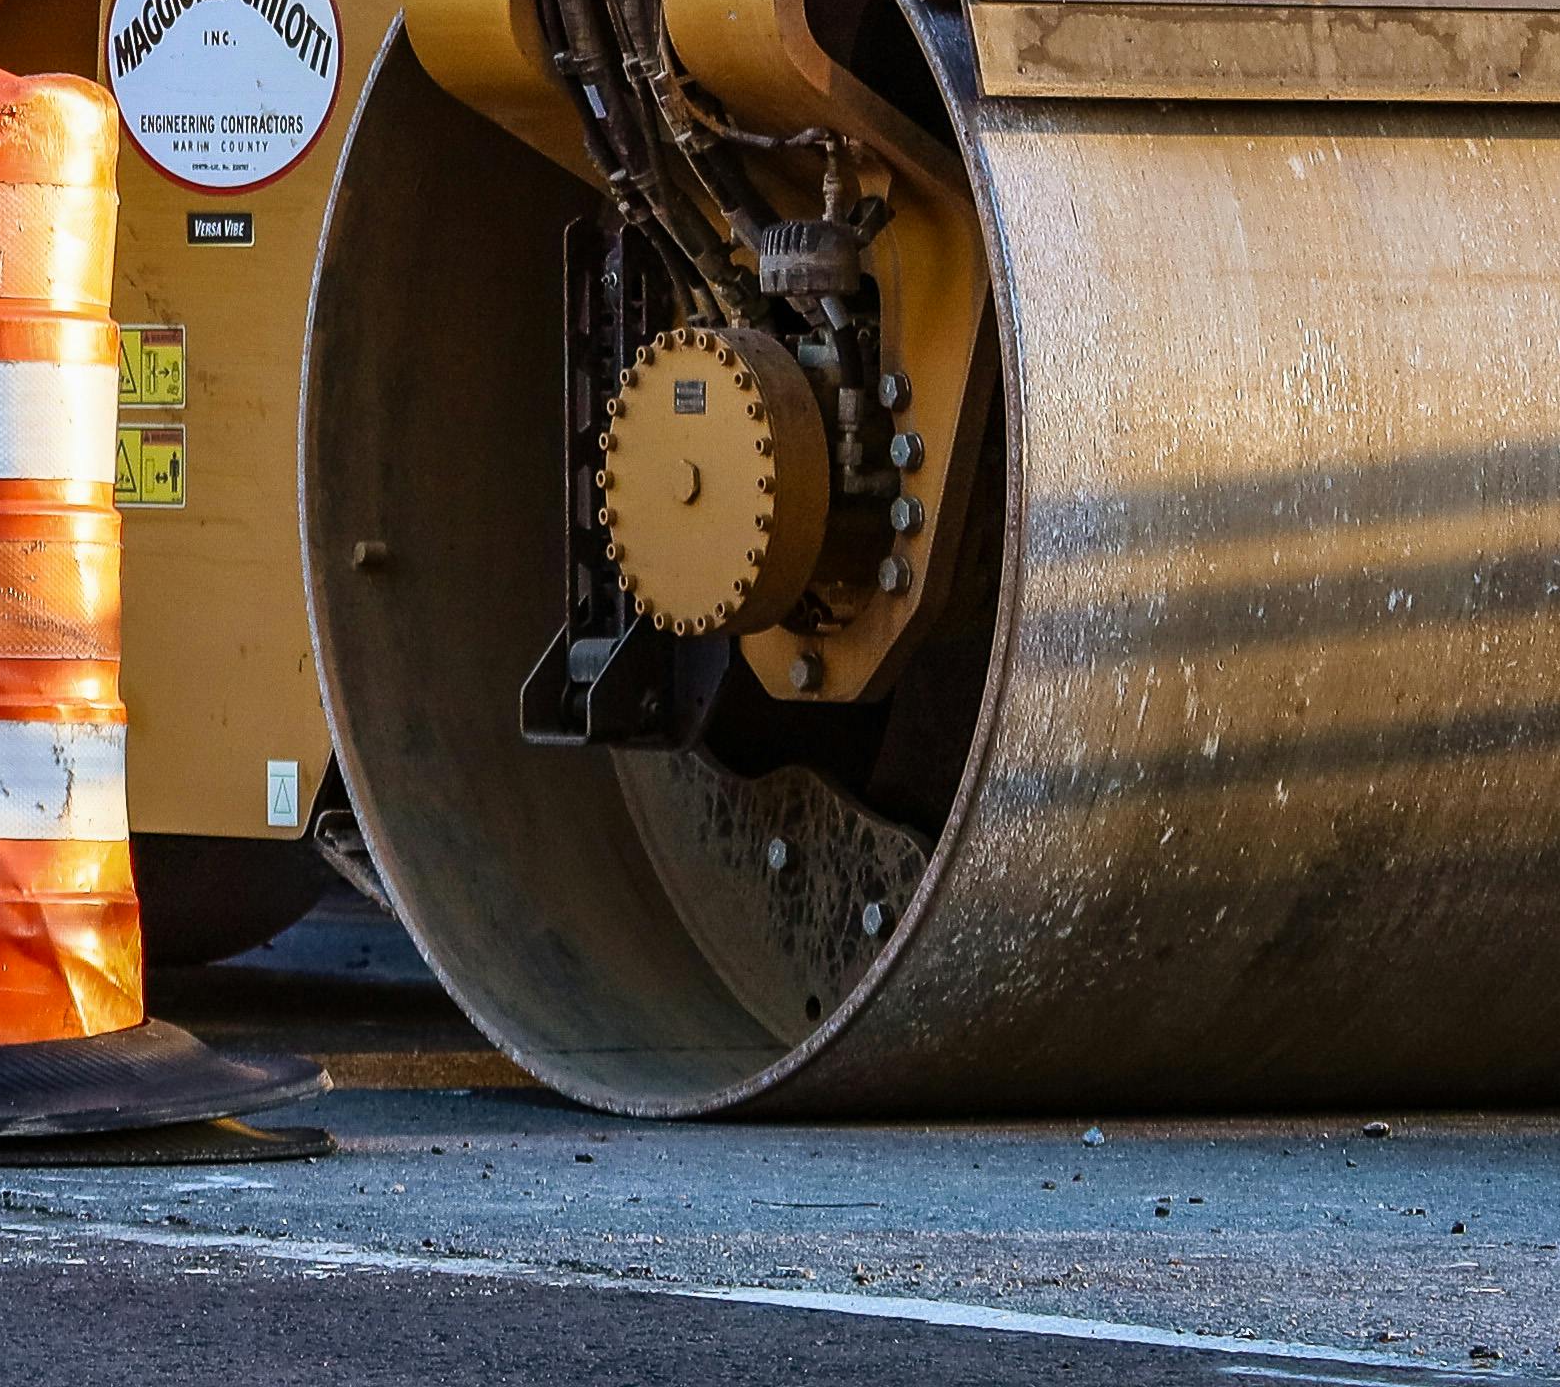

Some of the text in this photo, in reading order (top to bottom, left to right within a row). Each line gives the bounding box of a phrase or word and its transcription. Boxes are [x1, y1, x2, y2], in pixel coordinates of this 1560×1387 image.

[203, 30, 237, 47] INC.
[140, 114, 304, 134] ENGINEERING CONTRACTORS
[172, 140, 269, 152] MARIN COUNTY
